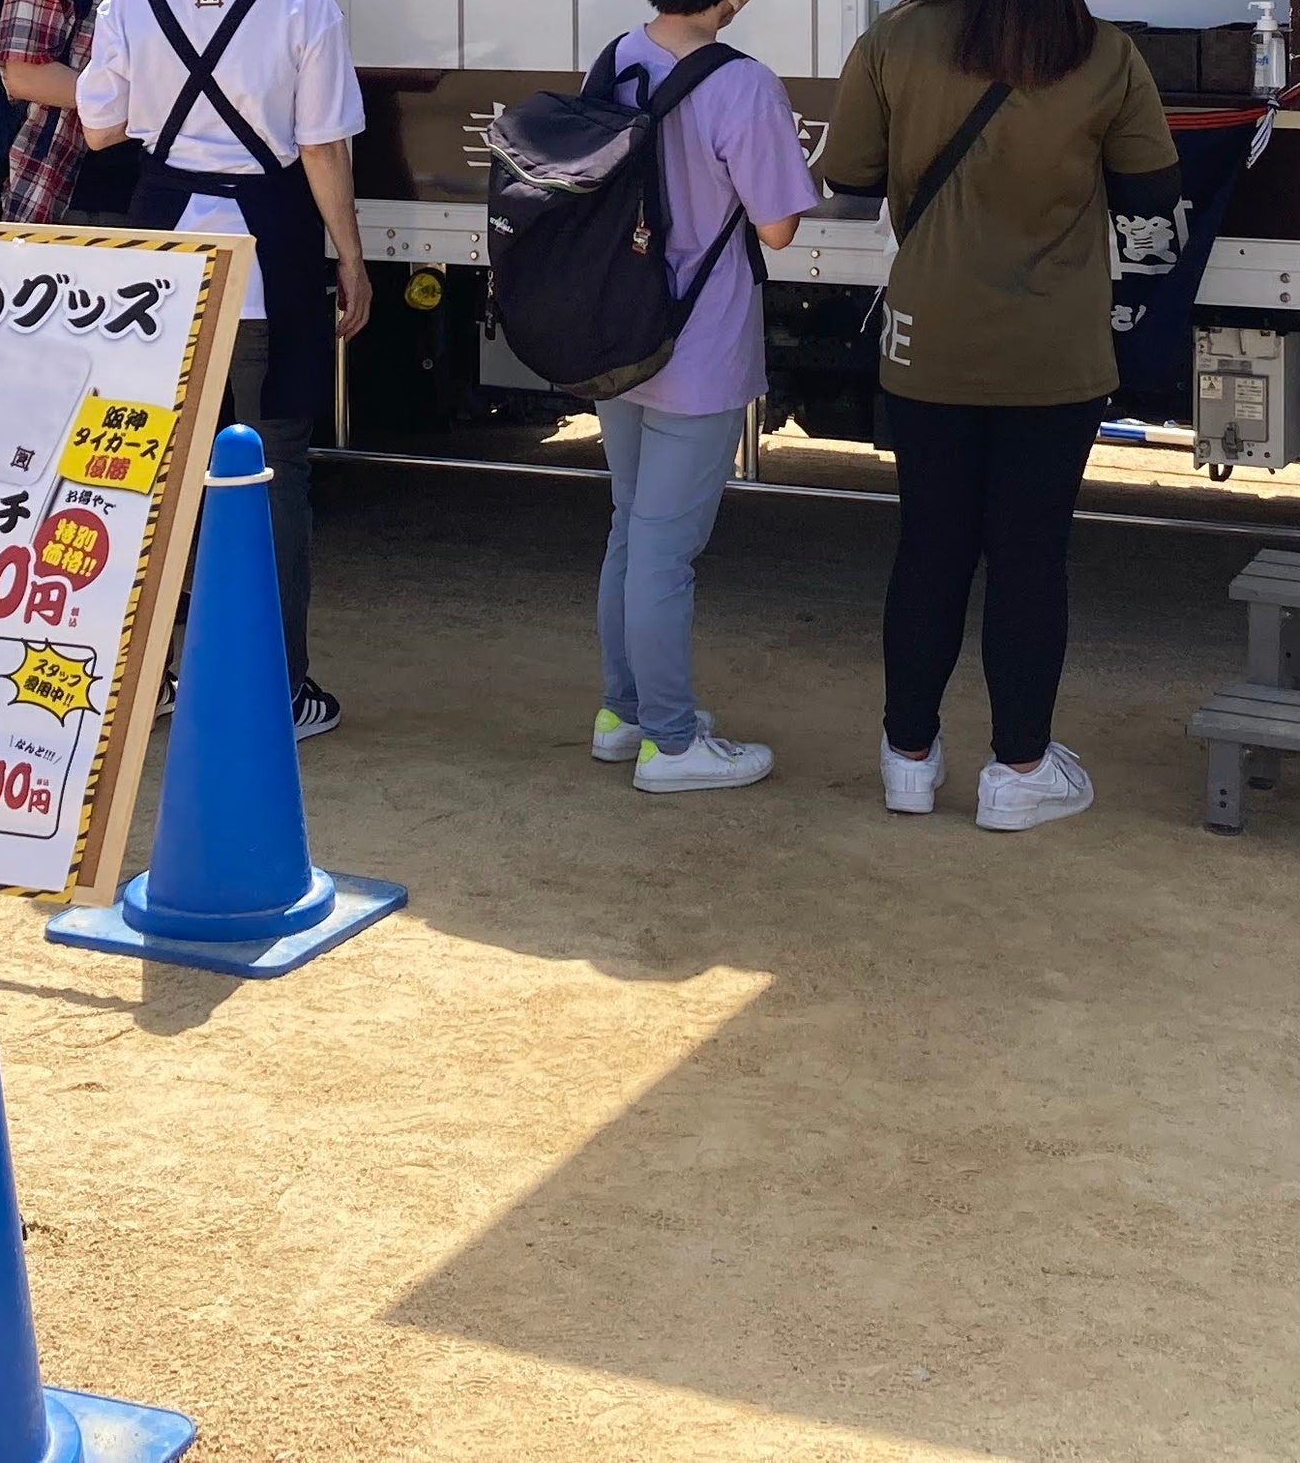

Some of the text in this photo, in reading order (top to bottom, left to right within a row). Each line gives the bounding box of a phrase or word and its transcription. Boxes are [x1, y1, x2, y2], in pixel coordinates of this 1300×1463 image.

[102, 406, 149, 431] 阪神
[73, 427, 159, 460] タイガース
[85, 454, 132, 481] 優勝
[65, 489, 117, 515] お得やで
[55, 519, 98, 552] 特別
[41, 540, 96, 578] 価格!!
[33, 658, 82, 687] スタッフ
